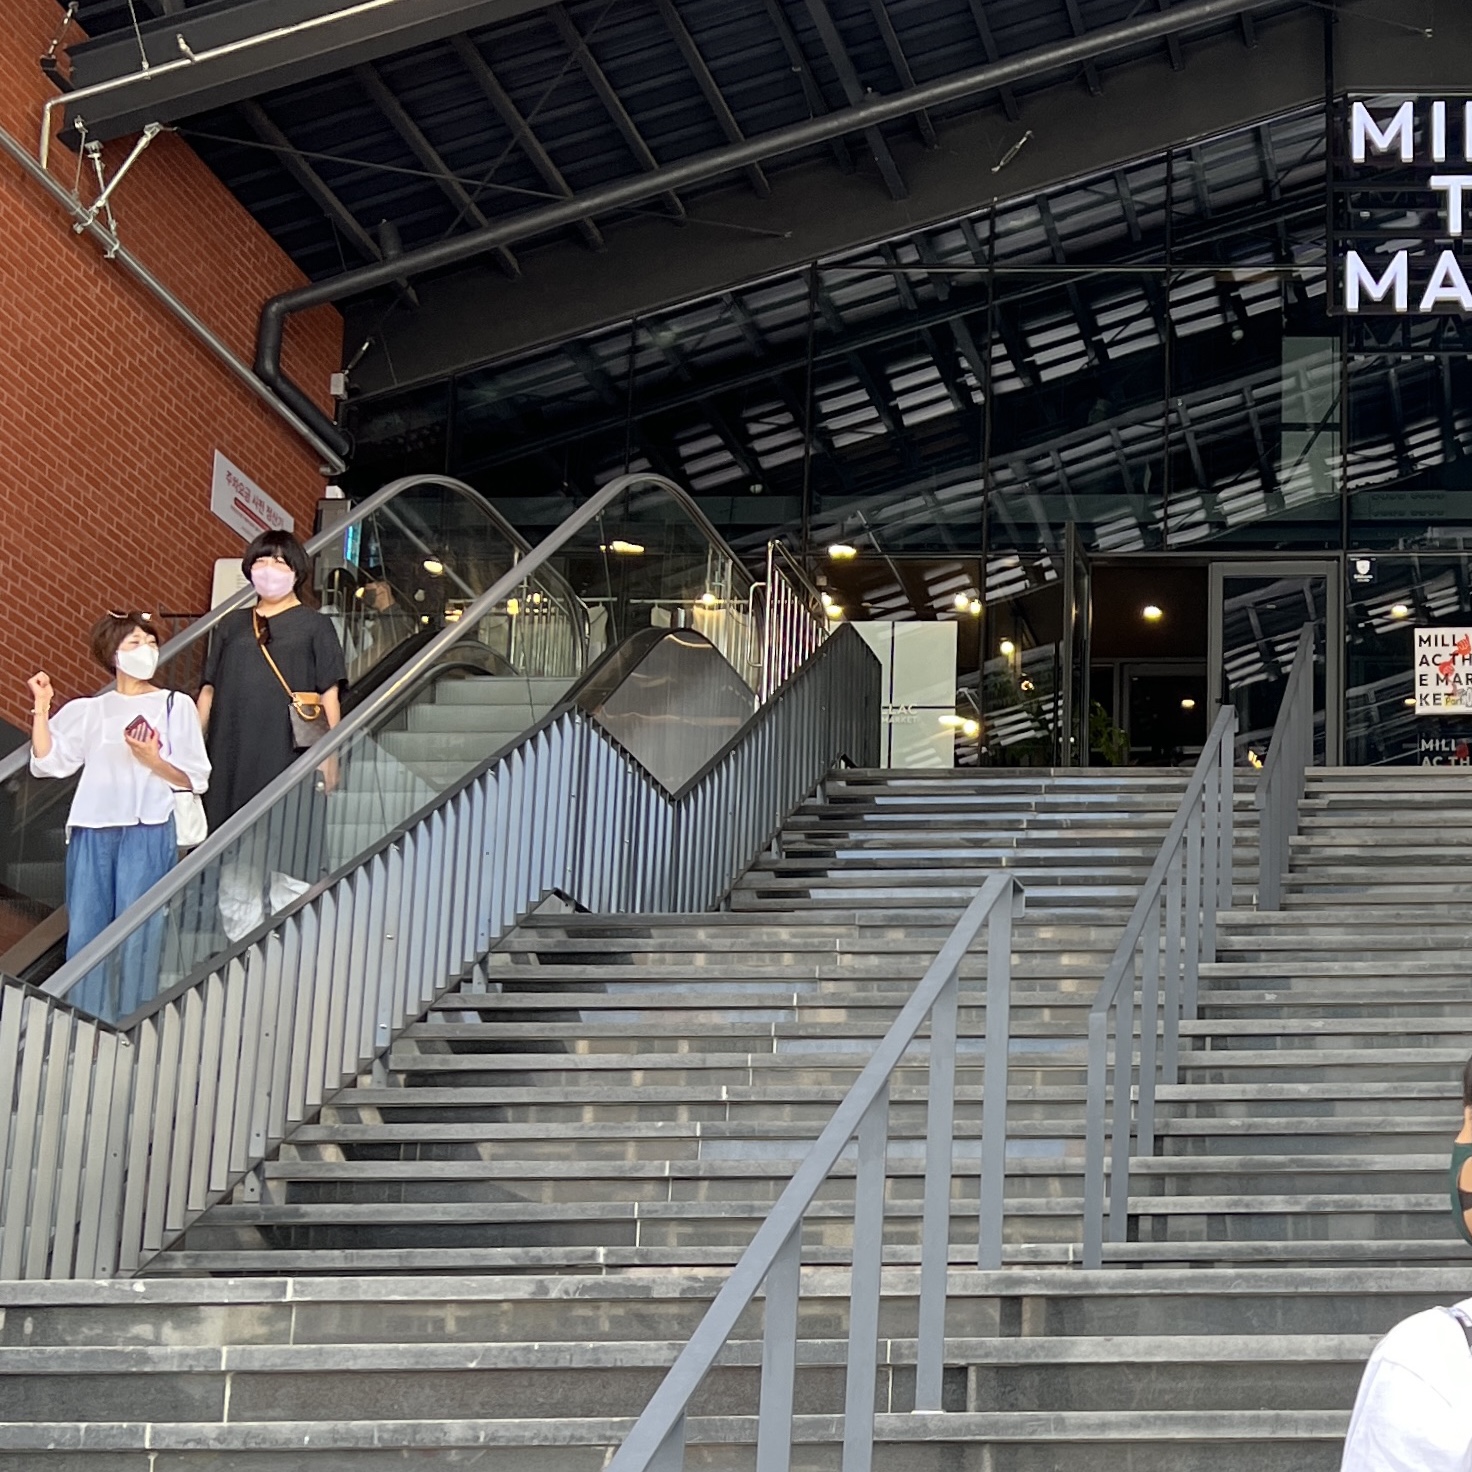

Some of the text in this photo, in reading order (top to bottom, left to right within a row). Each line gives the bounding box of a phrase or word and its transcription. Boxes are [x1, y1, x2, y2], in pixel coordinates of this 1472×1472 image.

[1418, 634, 1458, 648] MILL
[1419, 653, 1472, 667] AC TH
[1419, 673, 1429, 687] E
[1421, 738, 1457, 752] MILL
[1448, 755, 1471, 767] TH
